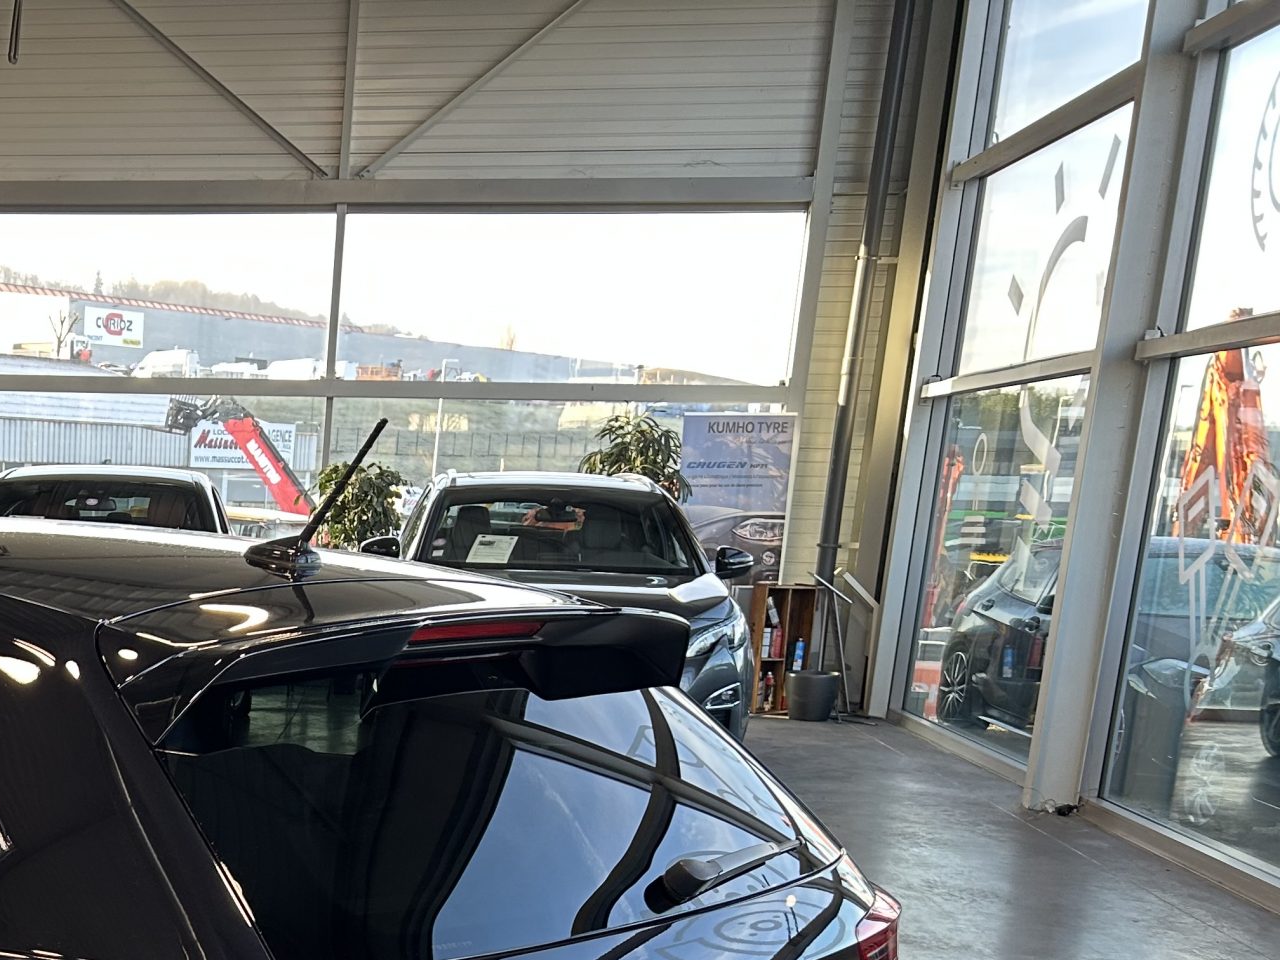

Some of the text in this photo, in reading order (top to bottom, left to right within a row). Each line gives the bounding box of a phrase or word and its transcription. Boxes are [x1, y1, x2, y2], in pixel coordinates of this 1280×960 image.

[96, 316, 133, 332] CURIOZ
[708, 421, 789, 434] KUMHO TYRE
[686, 461, 748, 469] CRUGEN
